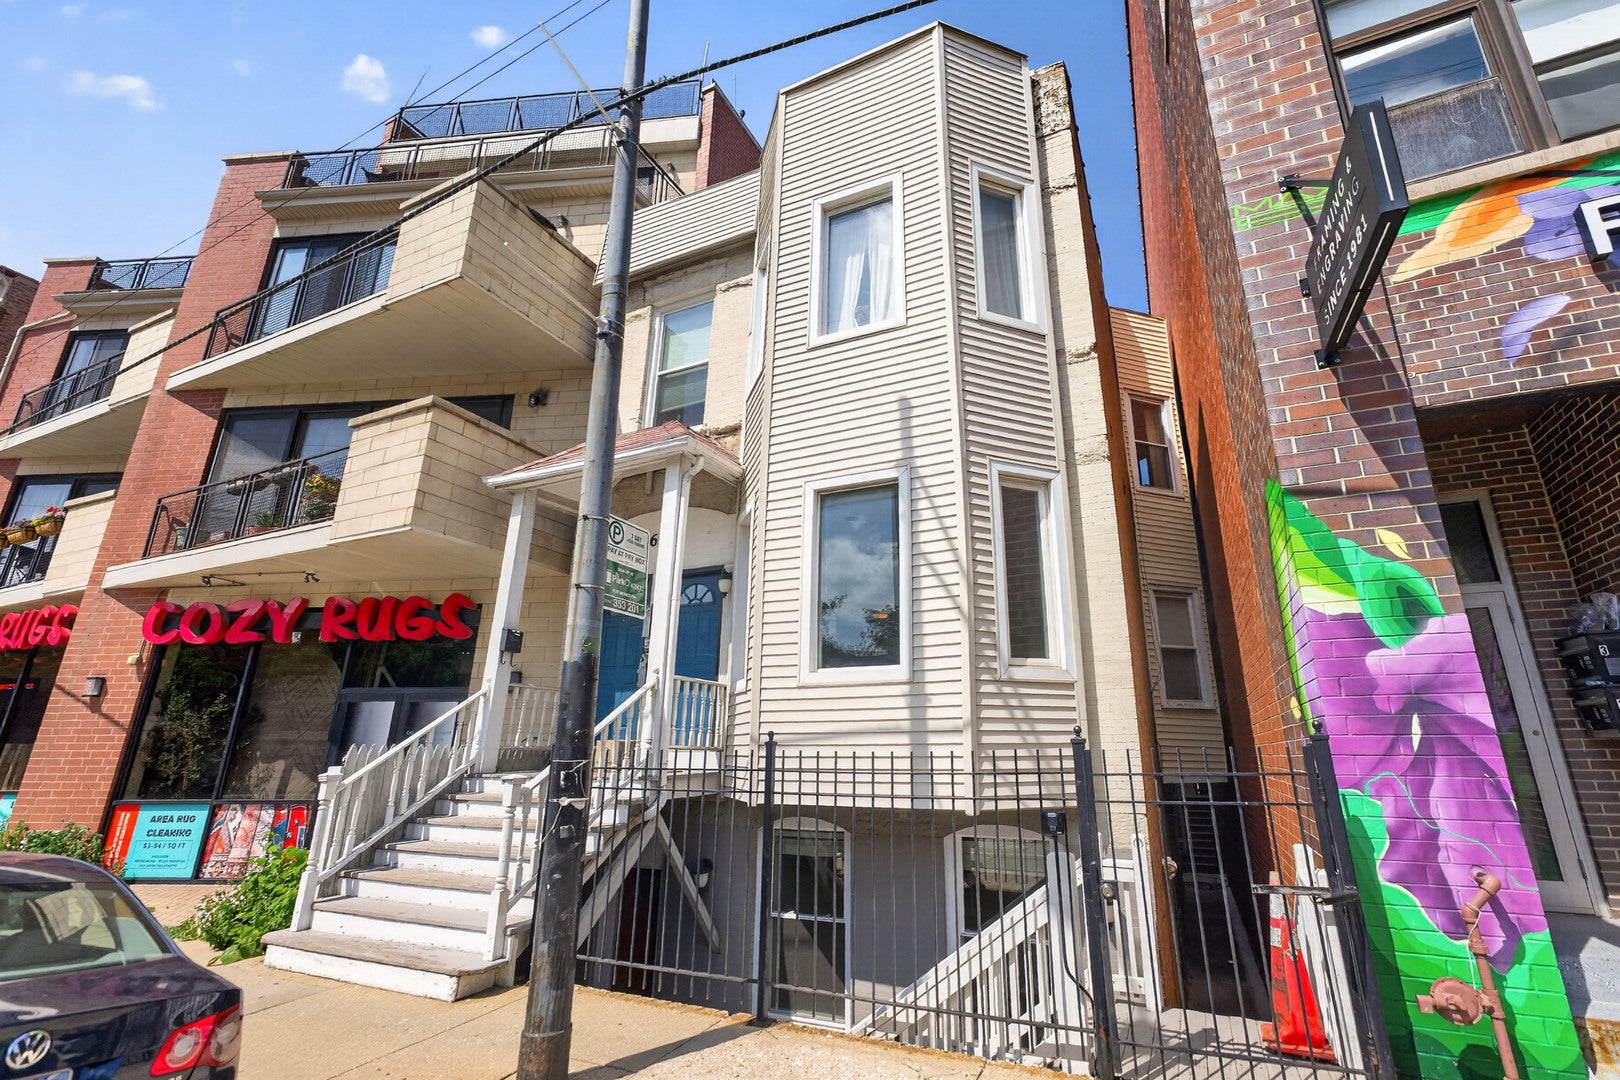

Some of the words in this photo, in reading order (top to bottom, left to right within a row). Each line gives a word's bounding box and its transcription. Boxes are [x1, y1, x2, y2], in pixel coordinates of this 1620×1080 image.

[1313, 177, 1345, 272] FRAMING
[1345, 156, 1352, 174] &
[1316, 175, 1360, 295] ENGRAVING
[1324, 265, 1347, 326] SINCE
[1346, 212, 1369, 271] 1981
[650, 533, 658, 547] 6
[608, 545, 618, 554] PAY
[613, 598, 627, 610] 353
[627, 602, 639, 614] 201
[142, 596, 309, 645] COZY
[320, 592, 478, 643] RUGS
[0, 604, 79, 652] RUGS
[1600, 645, 1608, 655] 3
[149, 815, 174, 823] AREA
[176, 815, 196, 823] RUG
[146, 829, 192, 837] CLEANING
